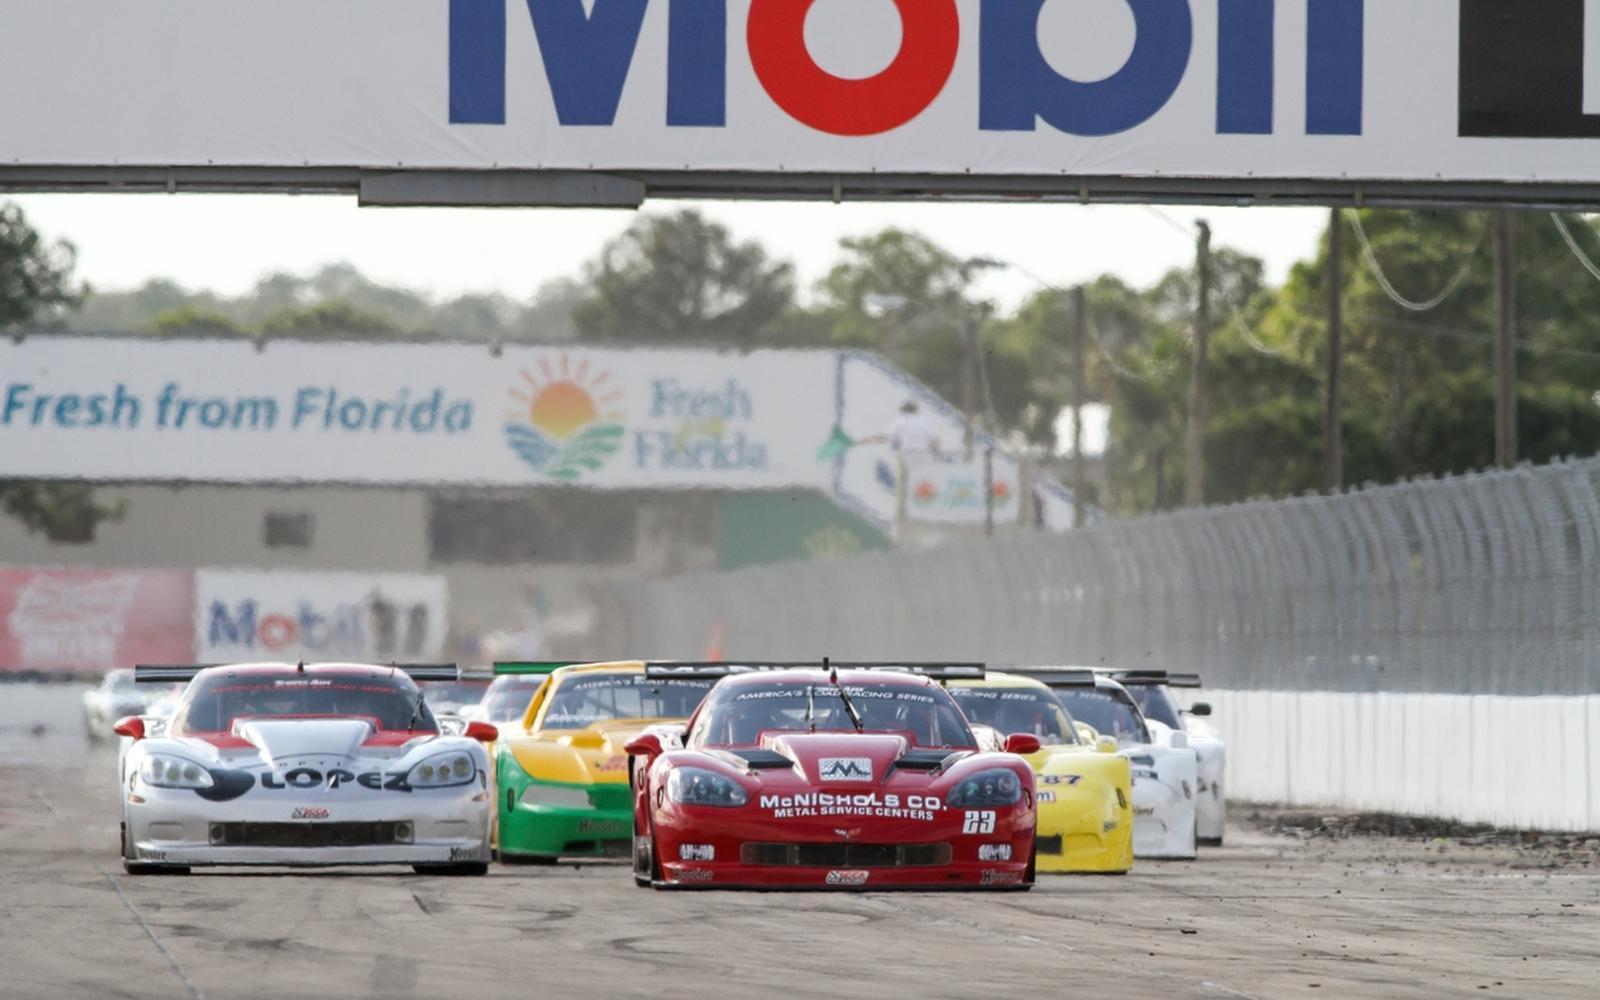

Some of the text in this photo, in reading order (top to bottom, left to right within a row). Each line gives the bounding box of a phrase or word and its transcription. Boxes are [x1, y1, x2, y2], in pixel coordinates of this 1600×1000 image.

[3, 381, 474, 433] Fresh from Florida
[737, 690, 803, 700] AMERICA'S
[897, 692, 935, 703] SERIES
[261, 768, 413, 793] LOPEZ
[760, 793, 948, 811] McNICHOLS CO.
[774, 806, 934, 821] METAL SERVICE CENTERS
[962, 811, 996, 834] 23
